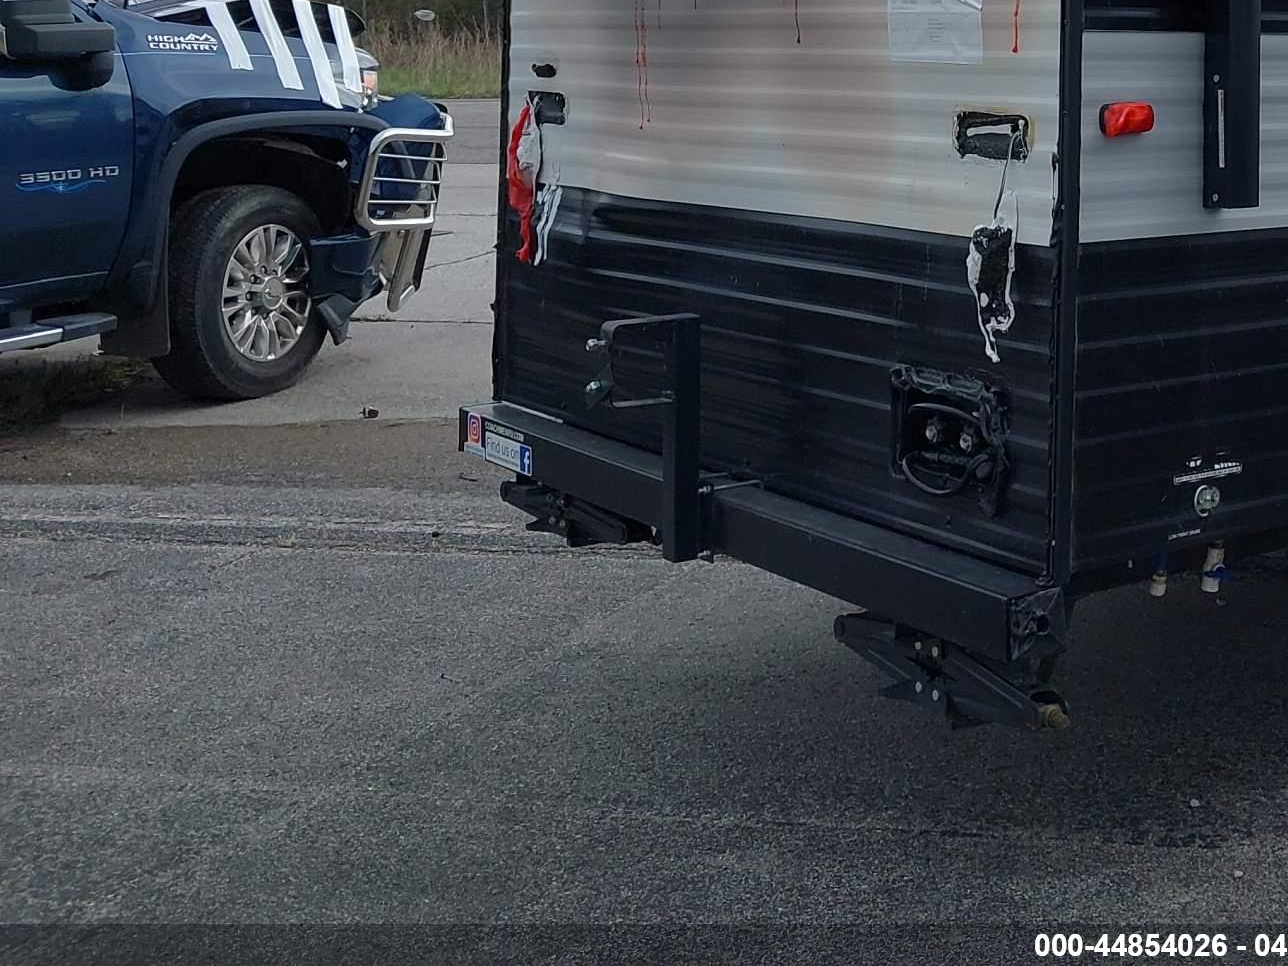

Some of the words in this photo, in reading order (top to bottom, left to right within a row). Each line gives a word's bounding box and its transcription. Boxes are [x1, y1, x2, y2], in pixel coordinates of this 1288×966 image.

[146, 34, 185, 43] HIGH
[148, 42, 219, 51] COUNTRY
[19, 168, 82, 184] 3500
[88, 165, 119, 178] HD
[486, 436, 501, 454] Find
[502, 445, 509, 457] us
[510, 448, 519, 460] on
